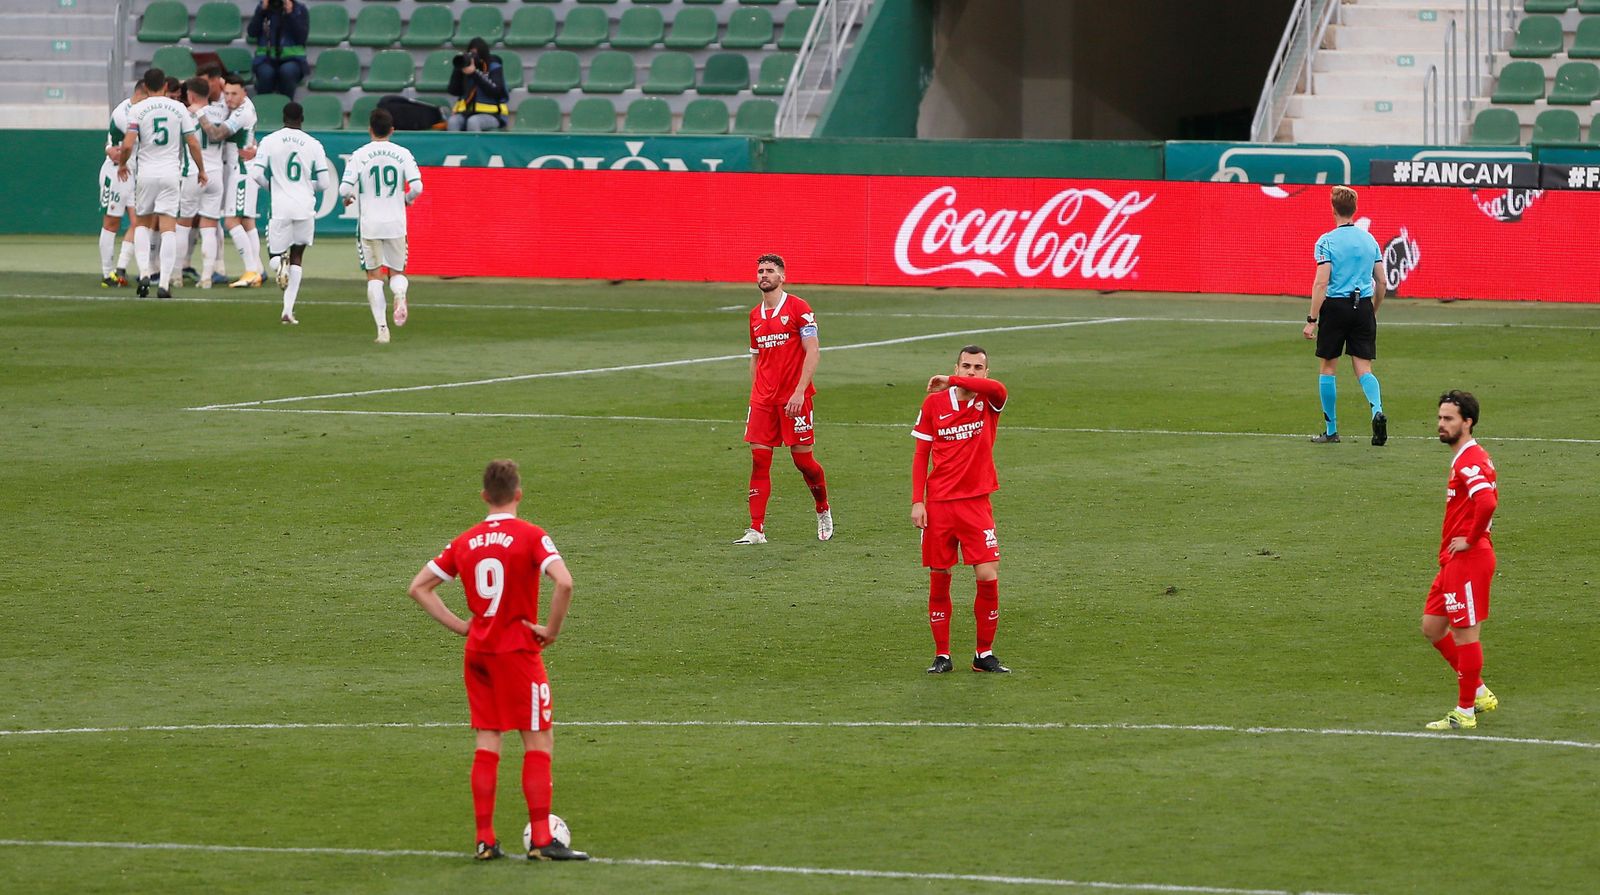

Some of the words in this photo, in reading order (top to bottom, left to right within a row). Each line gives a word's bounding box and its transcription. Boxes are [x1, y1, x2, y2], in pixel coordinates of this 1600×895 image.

[153, 116, 169, 146] 5
[287, 151, 301, 182] 6
[1393, 161, 1513, 185] #FANCAM
[1568, 166, 1600, 188] #F
[370, 165, 398, 197] 19
[894, 186, 1157, 280] Coca-Cola
[956, 431, 973, 440] BET
[468, 534, 484, 550] DE
[484, 532, 514, 549] JONG
[475, 557, 505, 618] 9
[540, 683, 550, 707] 9
